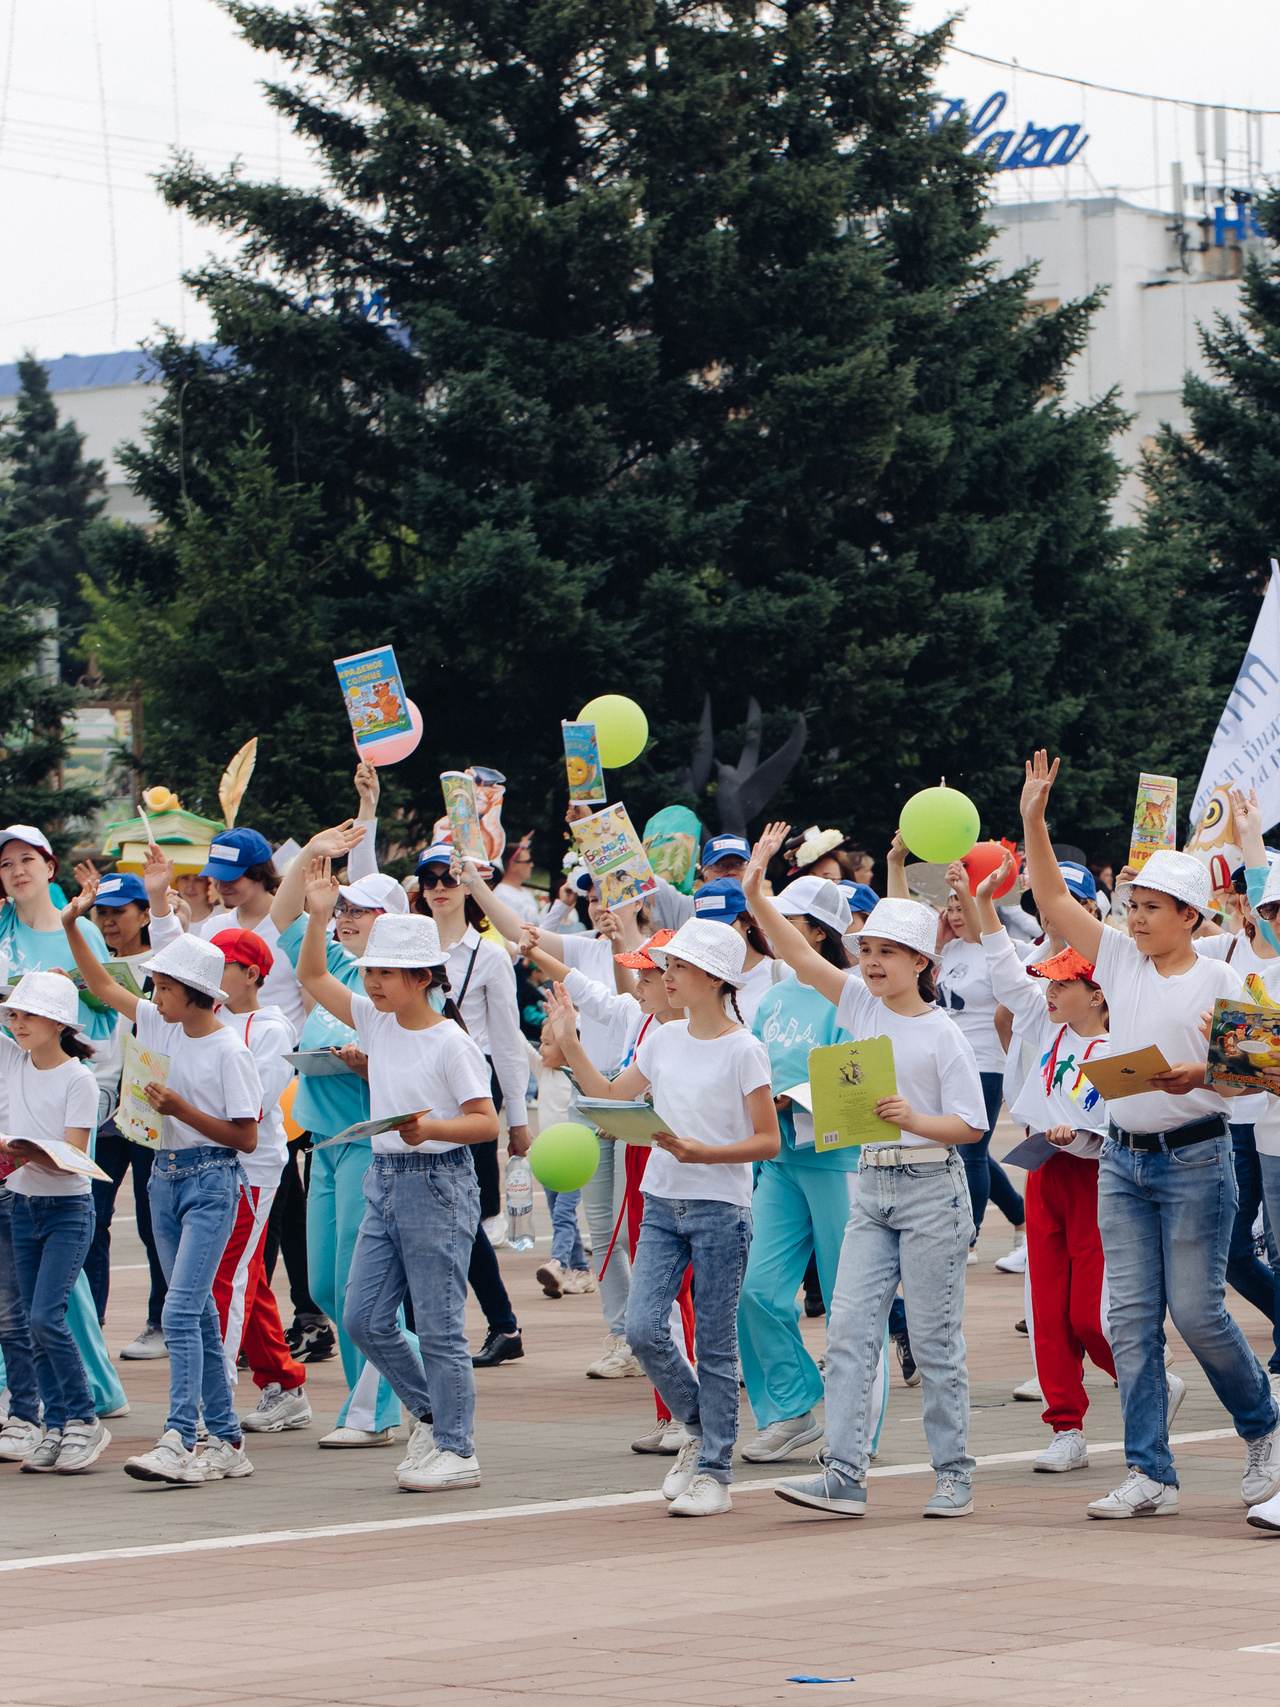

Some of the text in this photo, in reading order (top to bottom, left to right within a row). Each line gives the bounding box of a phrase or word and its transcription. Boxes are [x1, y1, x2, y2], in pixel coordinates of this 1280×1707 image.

[338, 659, 384, 680] КРАДЕНОЕ
[346, 669, 382, 687] СОЛНЦЕ
[1130, 850, 1152, 861] ИГР
